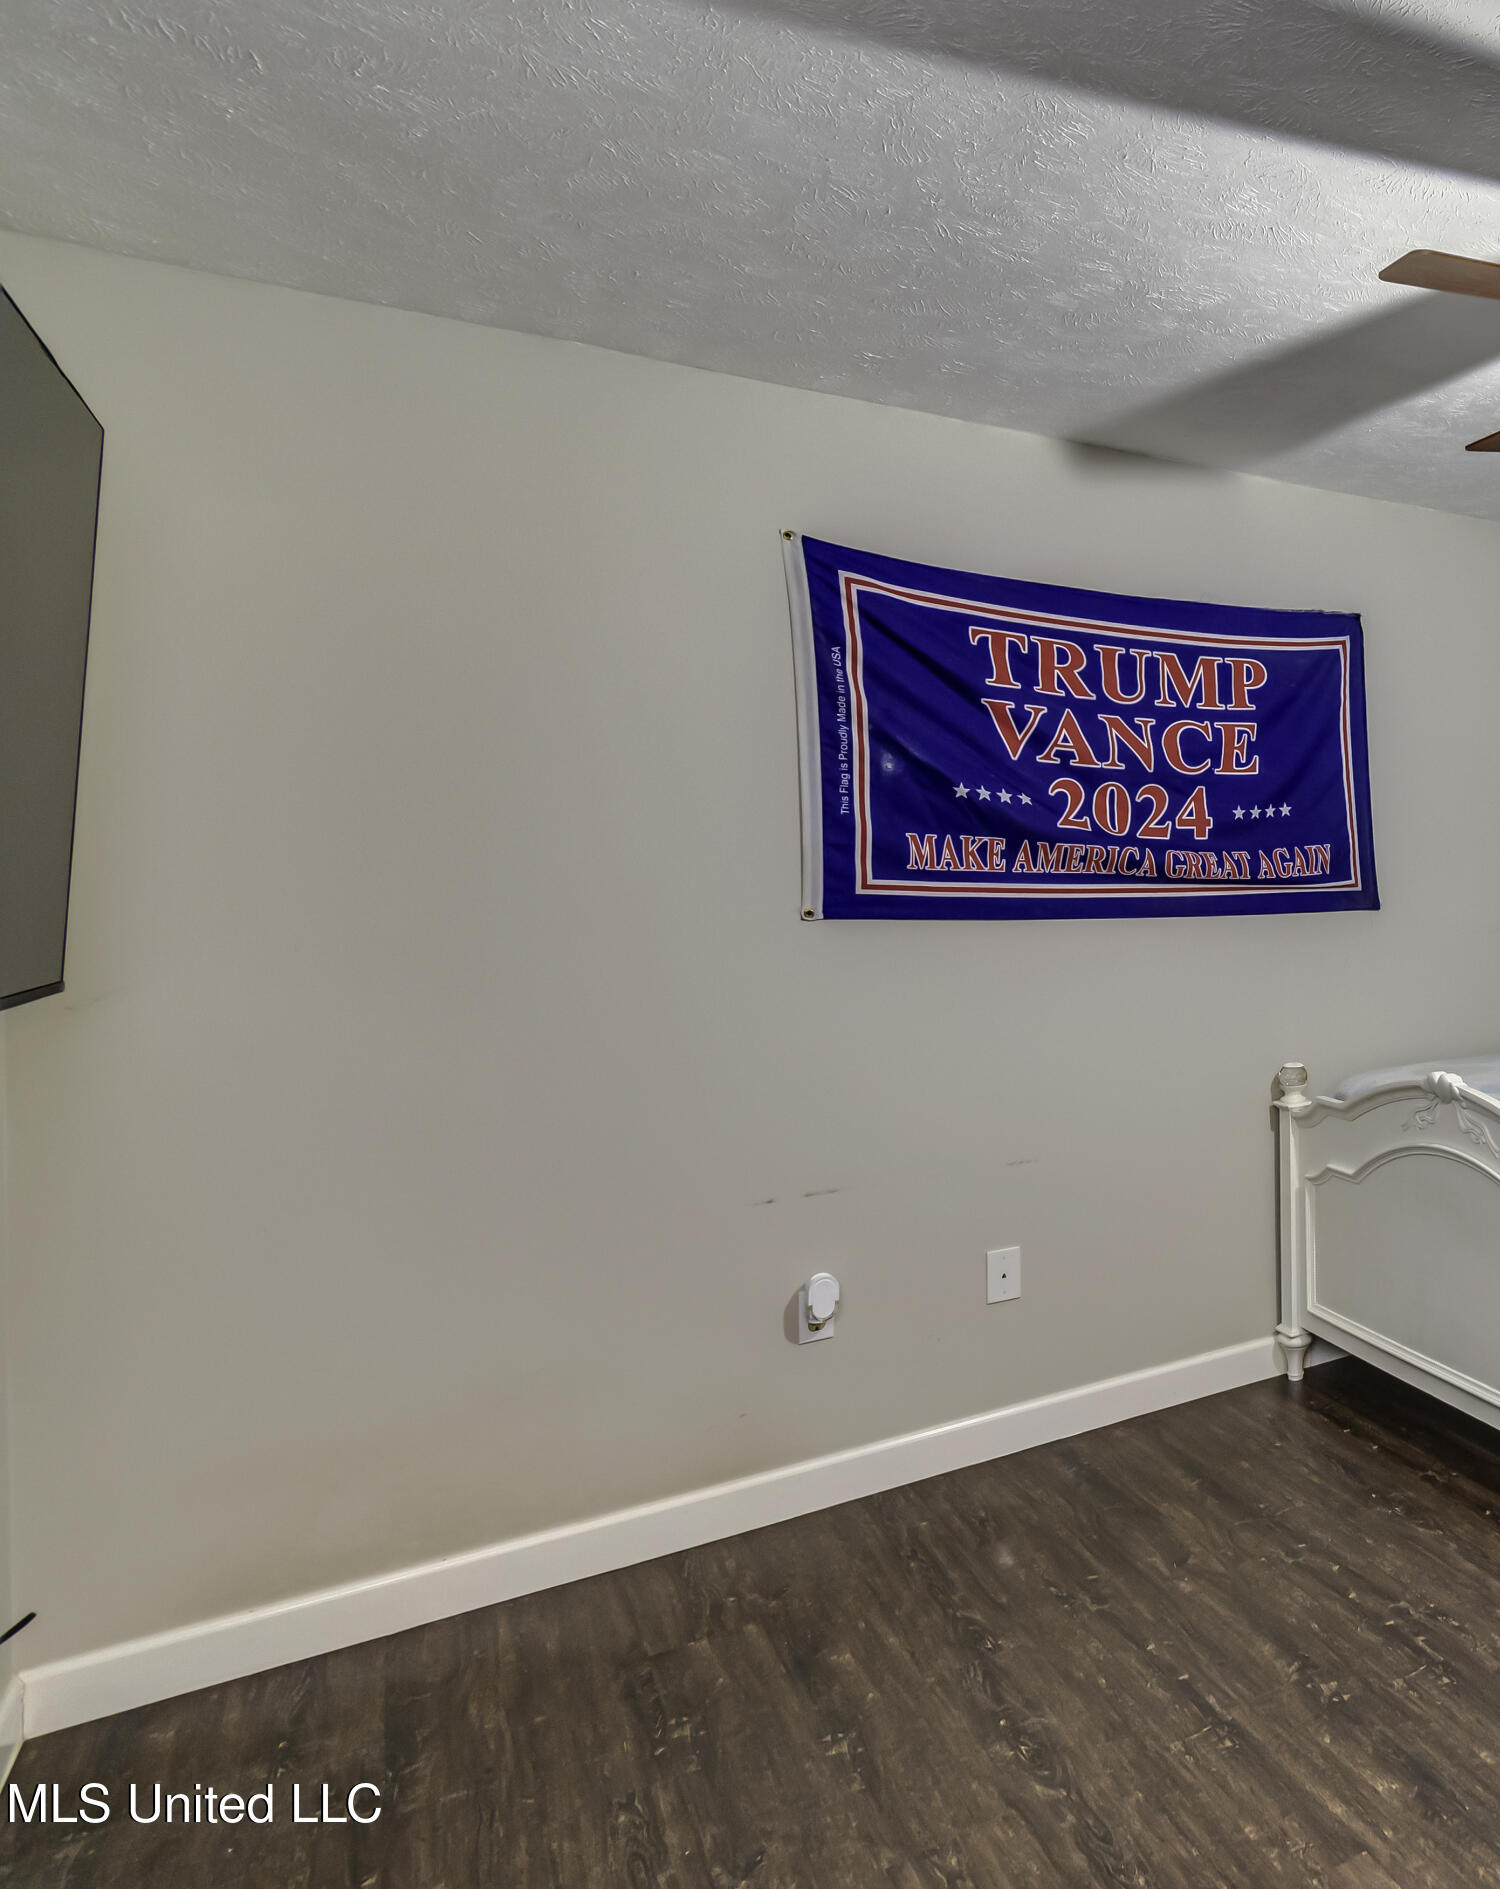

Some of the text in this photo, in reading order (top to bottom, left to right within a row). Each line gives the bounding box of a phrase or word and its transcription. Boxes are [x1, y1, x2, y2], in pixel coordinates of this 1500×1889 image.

[969, 626, 1268, 711] TRUMP
[831, 646, 851, 815] This Flag is Proudly Made in the USA
[981, 697, 1260, 775] VANCE
[1048, 778, 1213, 840] 2024
[905, 833, 1331, 880] MAKE AMERICA GREAT AGAIN
